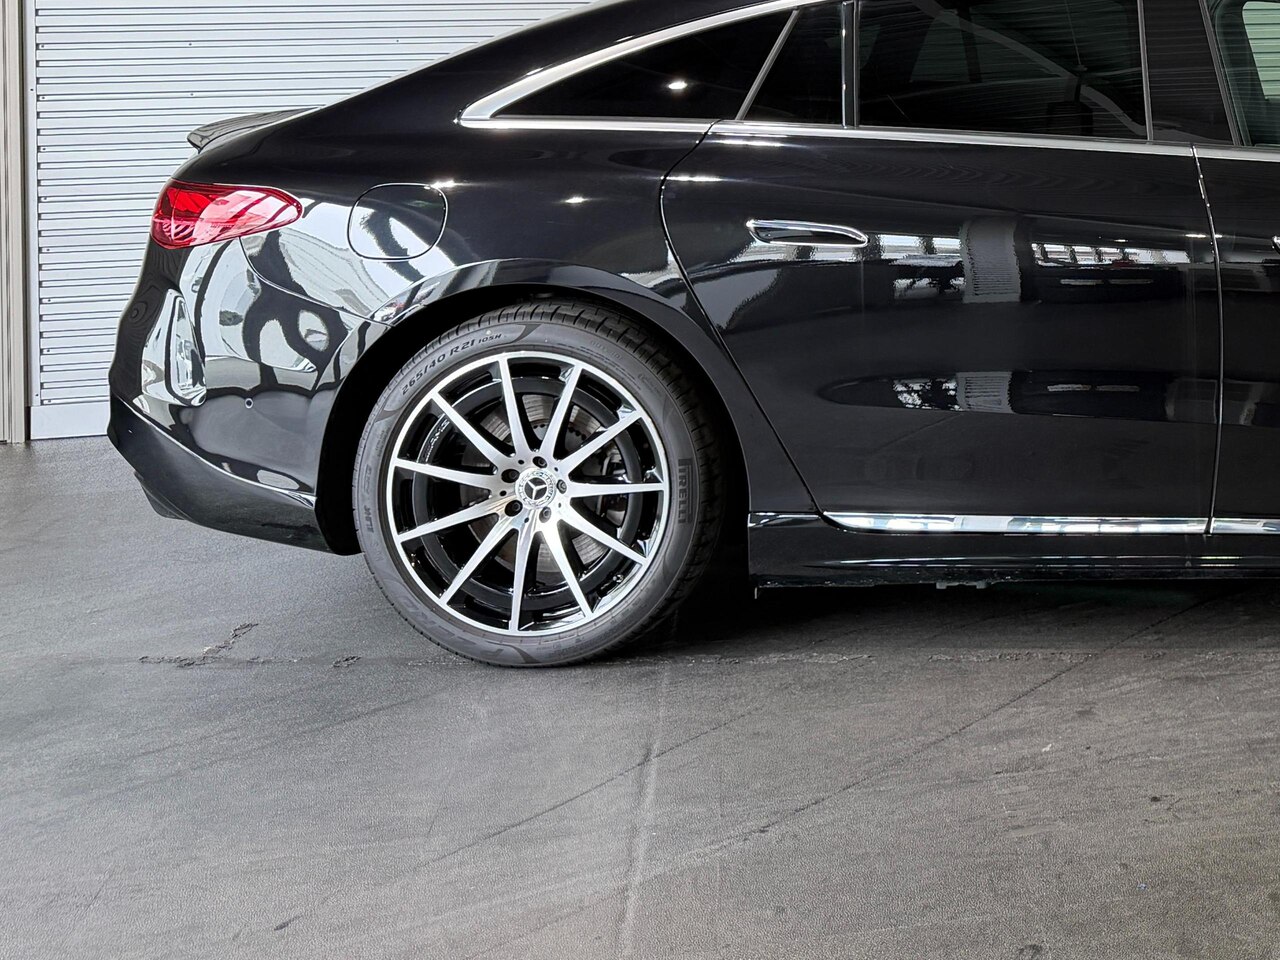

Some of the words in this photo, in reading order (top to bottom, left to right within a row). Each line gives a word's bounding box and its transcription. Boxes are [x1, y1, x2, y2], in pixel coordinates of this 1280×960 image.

[402, 353, 446, 396] 265/40
[449, 338, 476, 357] R21
[677, 458, 694, 524] PIRELLI
